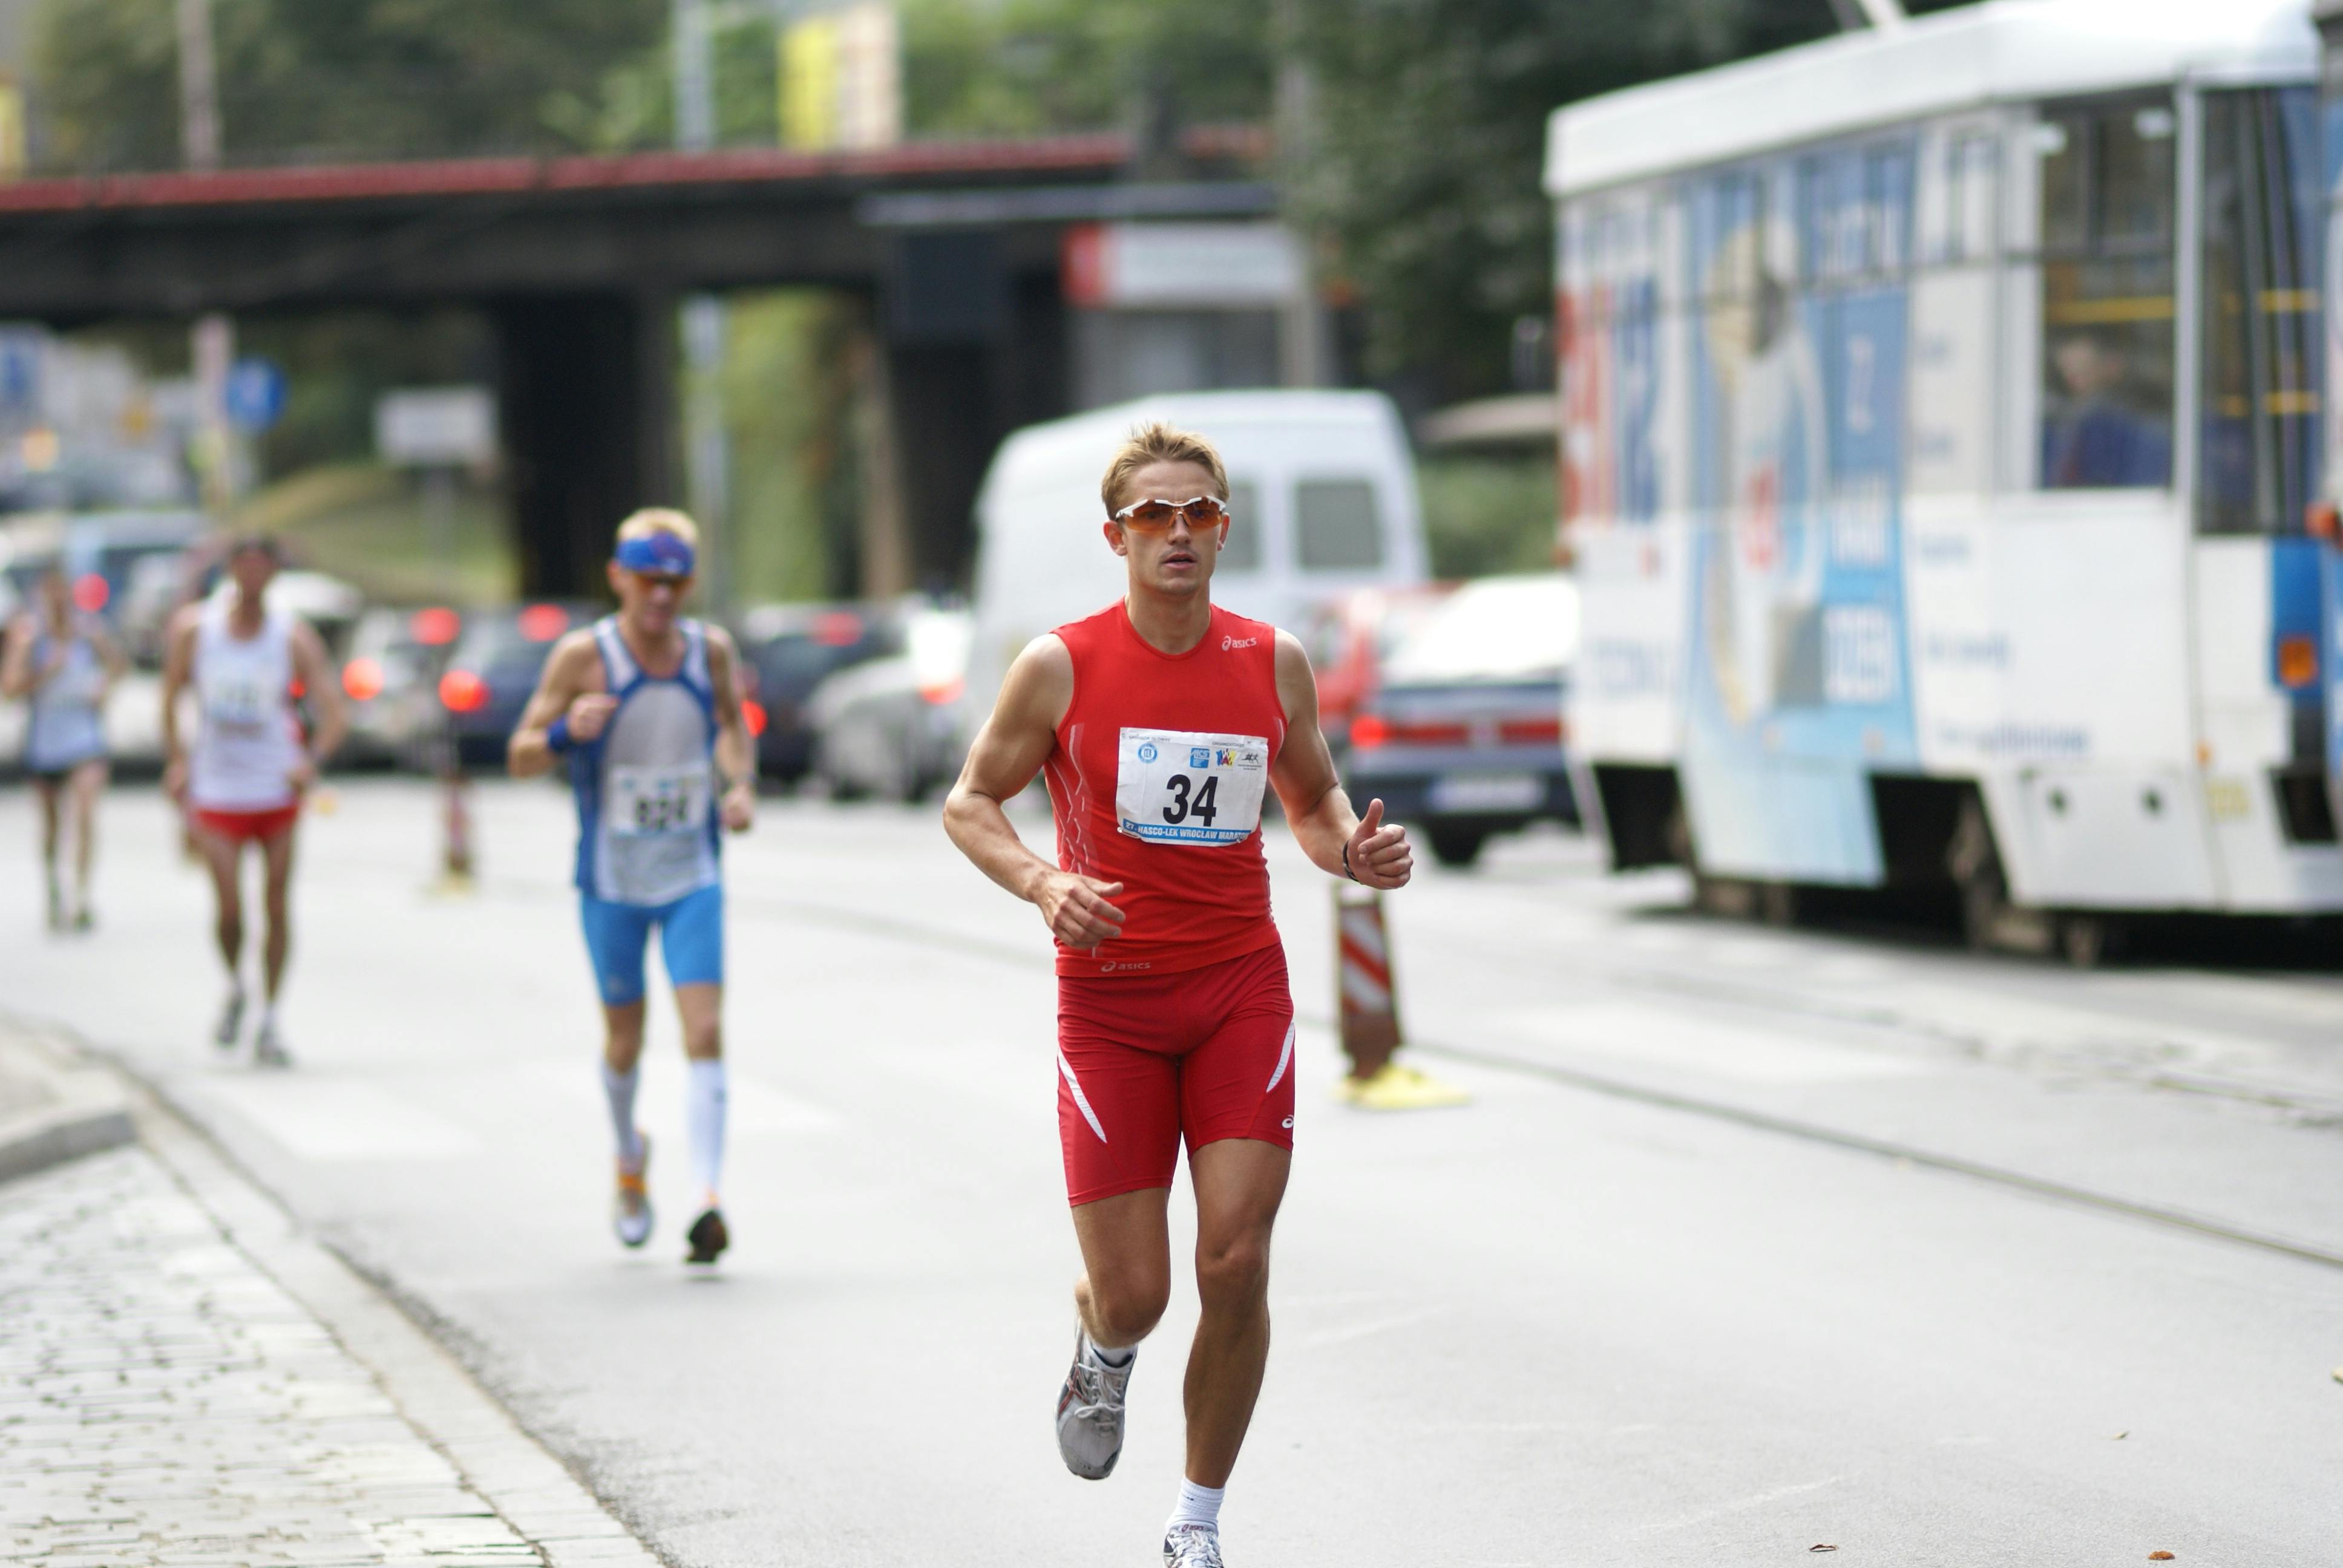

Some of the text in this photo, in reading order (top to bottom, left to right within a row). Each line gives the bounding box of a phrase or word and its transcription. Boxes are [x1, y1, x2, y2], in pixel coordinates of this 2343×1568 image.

[1231, 636, 1257, 648] asics
[1163, 774, 1219, 827] 34
[1138, 826, 1179, 837] HASCO-LEK
[1118, 962, 1152, 970] asics
